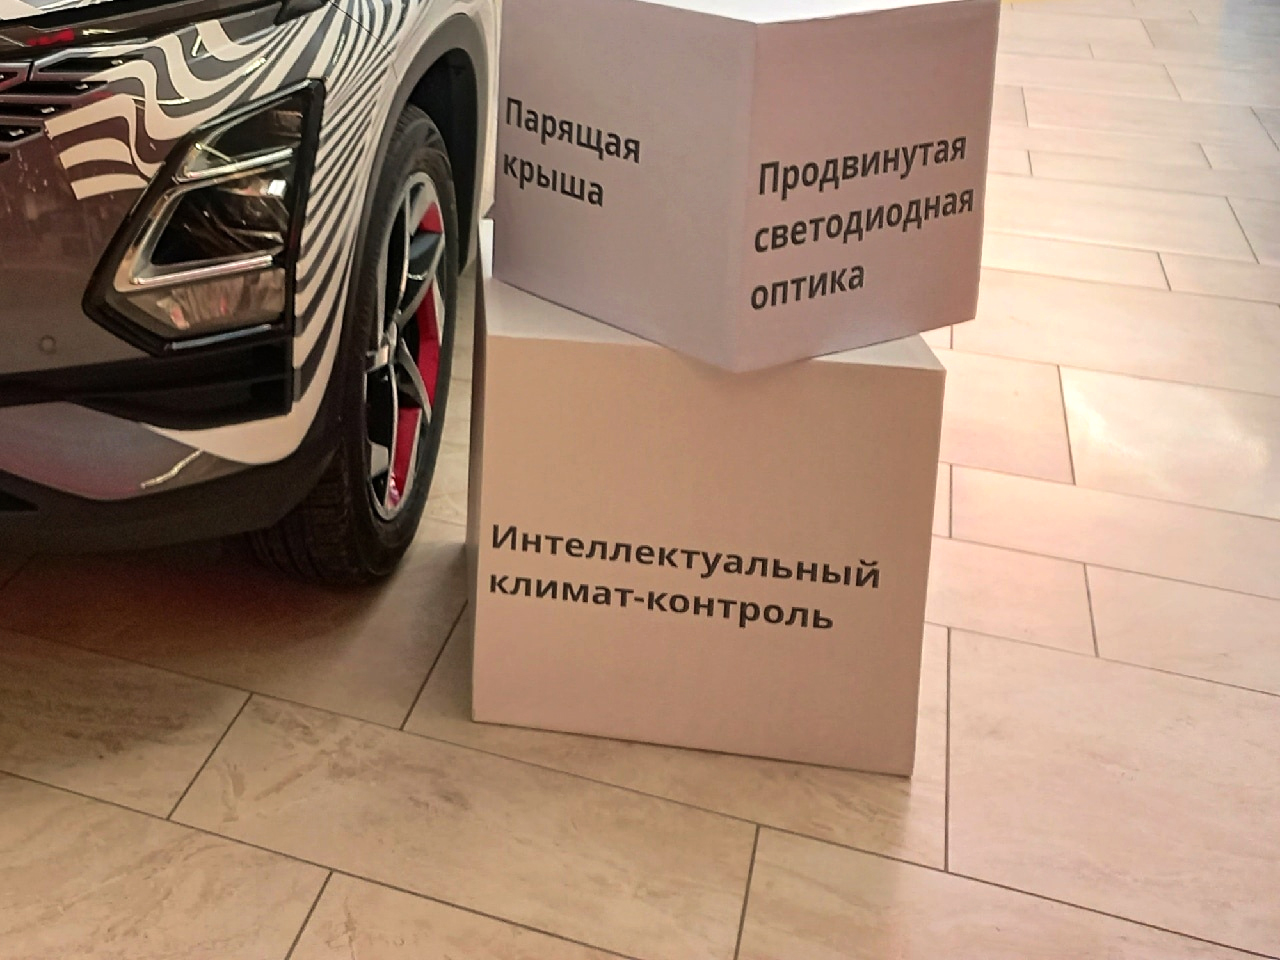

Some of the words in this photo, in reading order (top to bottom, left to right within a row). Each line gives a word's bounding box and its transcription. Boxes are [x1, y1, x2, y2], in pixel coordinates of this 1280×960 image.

[505, 97, 641, 164] Парящая
[502, 150, 605, 207] крыша
[758, 136, 968, 201] Продвинутая
[753, 187, 975, 253] светодиодная
[750, 261, 866, 311] оптика
[491, 523, 880, 588] Интеллектуальный
[488, 572, 834, 629] климат-контроль
